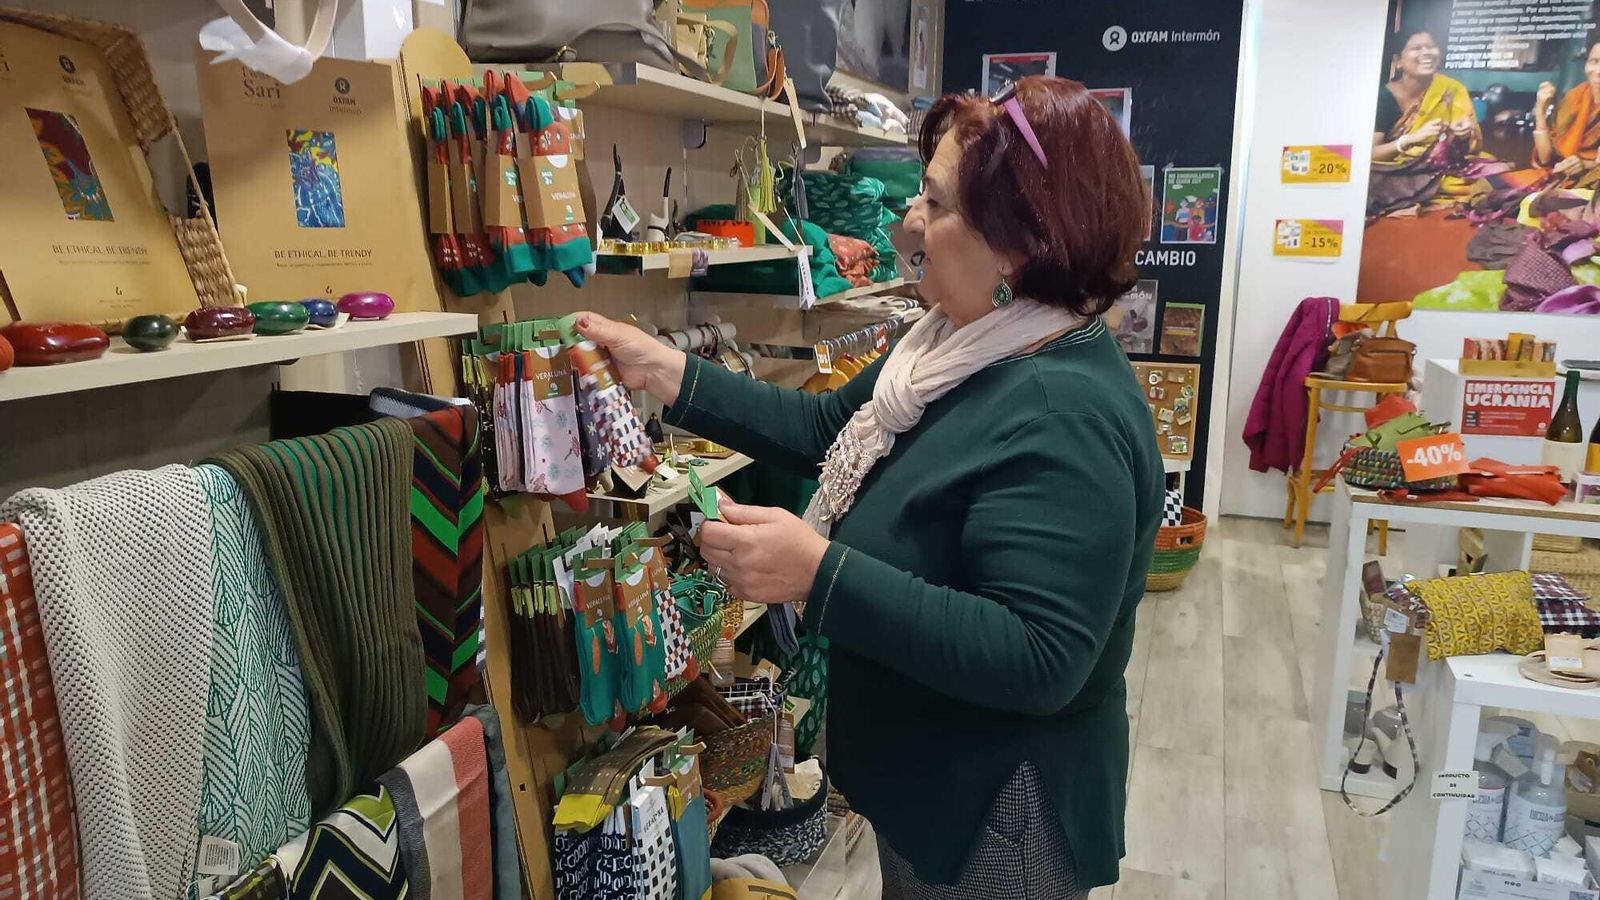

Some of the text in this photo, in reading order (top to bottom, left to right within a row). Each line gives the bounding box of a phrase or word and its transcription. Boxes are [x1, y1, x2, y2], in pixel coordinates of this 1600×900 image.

[1131, 28, 1220, 43] OXFAM Intermón
[1445, 61, 1472, 69] FUTURO
[243, 79, 281, 99] Sari
[333, 96, 356, 106] OXFAM
[1313, 163, 1347, 175] -20%
[551, 191, 577, 201] VERALUNA
[1305, 237, 1339, 248] -15%
[274, 249, 285, 258] BE
[327, 249, 338, 258] BE
[340, 249, 372, 258] TRENDY
[1134, 250, 1196, 266] CAMBIO
[536, 367, 568, 381] VERALUNA
[1466, 382, 1553, 396] EMERGENCIA
[1465, 394, 1551, 408] UCRANIA
[1406, 442, 1463, 467] -40%
